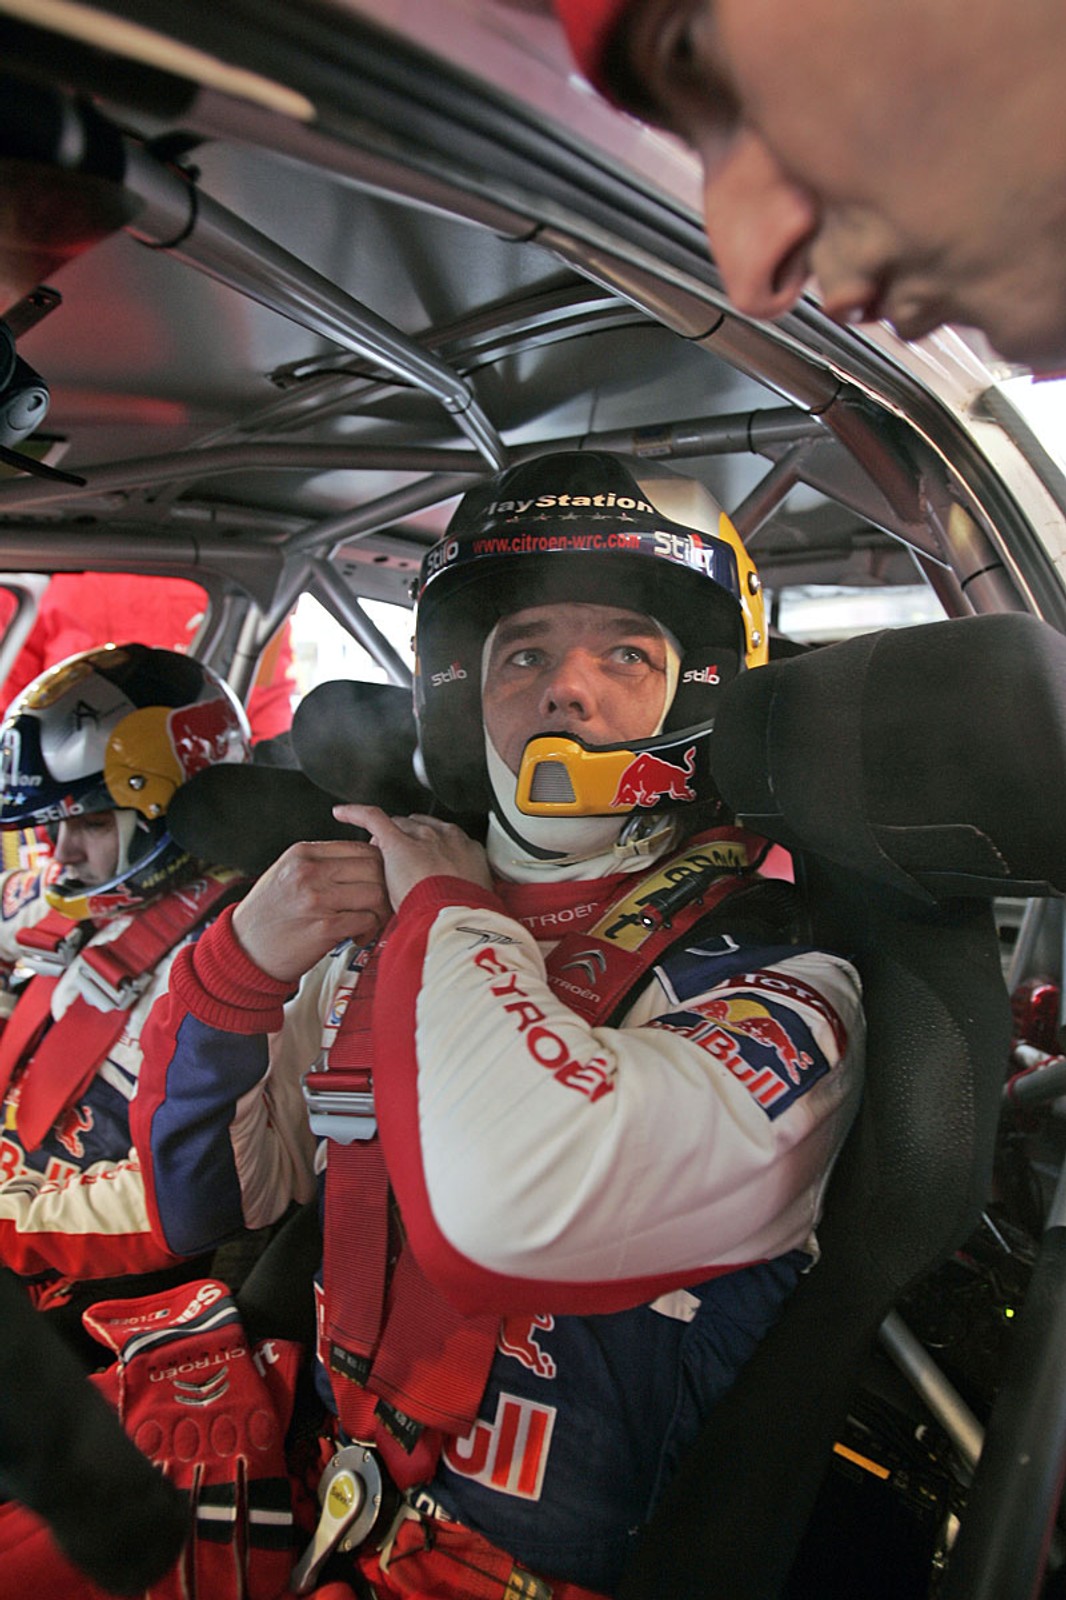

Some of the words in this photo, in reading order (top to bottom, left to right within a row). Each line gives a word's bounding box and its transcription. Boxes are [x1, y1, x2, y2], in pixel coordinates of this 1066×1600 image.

[483, 492, 655, 515] layStation
[473, 533, 641, 554] www.citroen-wrc.com
[431, 662, 467, 686] Stilo
[682, 665, 721, 685] Stilo
